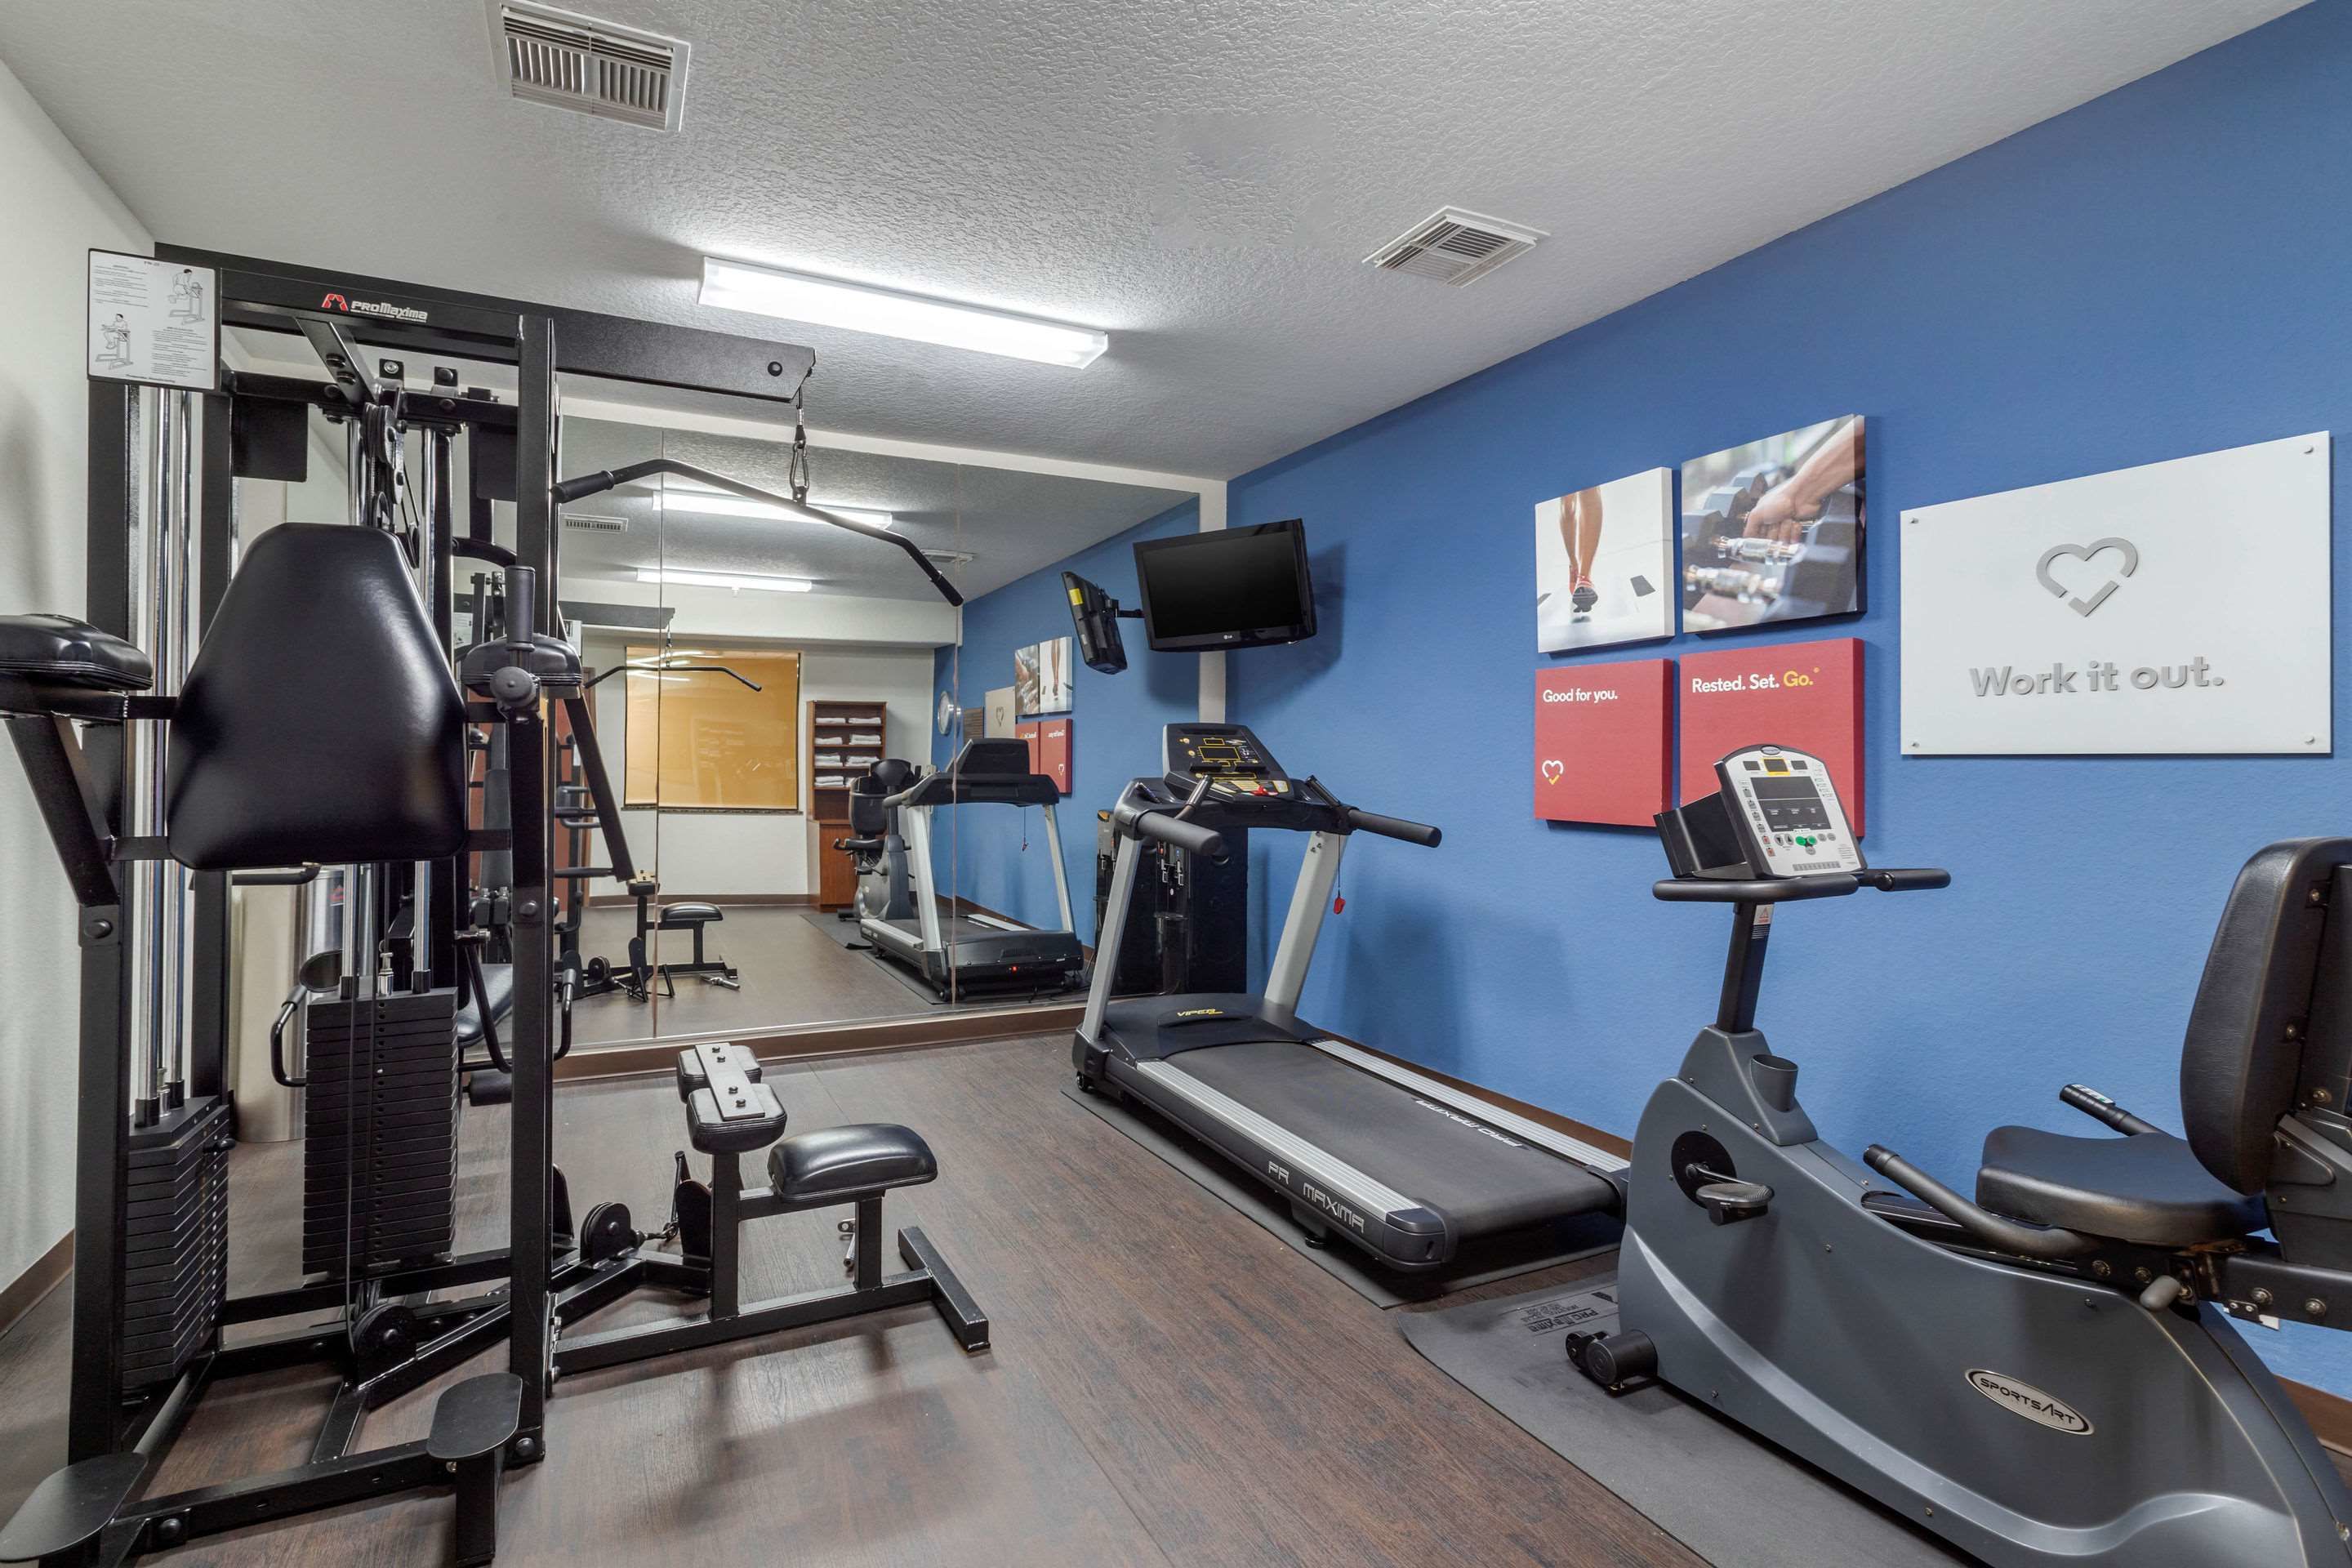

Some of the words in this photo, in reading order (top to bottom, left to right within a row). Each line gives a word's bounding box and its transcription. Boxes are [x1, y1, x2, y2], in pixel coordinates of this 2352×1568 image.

[1692, 675, 1746, 693] Rested.
[1749, 674, 1780, 690] Set.
[1969, 662, 2078, 697] Work
[2087, 660, 2118, 692] it
[2130, 656, 2225, 689] out.
[1543, 688, 1574, 702] Good
[1575, 688, 1592, 702] for
[1593, 689, 1618, 703] you.
[1303, 1183, 1365, 1234] MAXIMA
